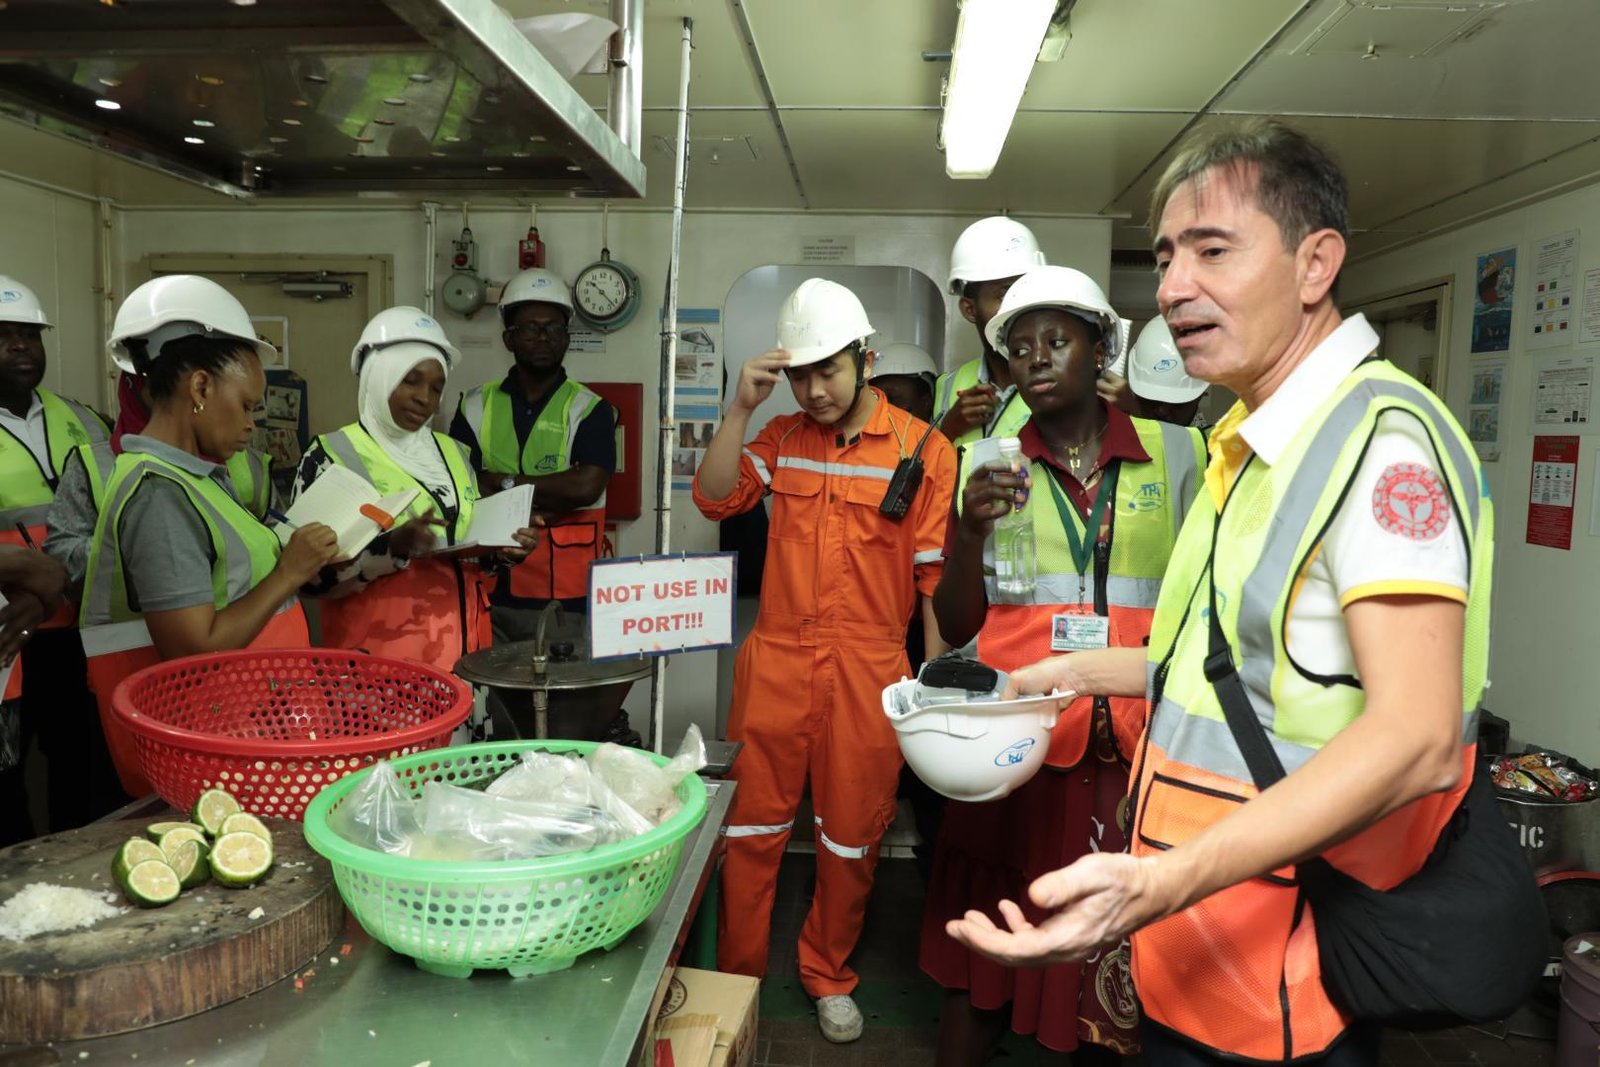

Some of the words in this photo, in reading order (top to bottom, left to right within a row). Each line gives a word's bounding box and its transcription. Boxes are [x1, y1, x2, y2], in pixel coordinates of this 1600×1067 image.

[596, 584, 645, 605] NOT
[653, 580, 698, 600] USE
[705, 578, 728, 596] IN
[622, 612, 703, 636] PORT!!!
[1508, 822, 1544, 849] IC
